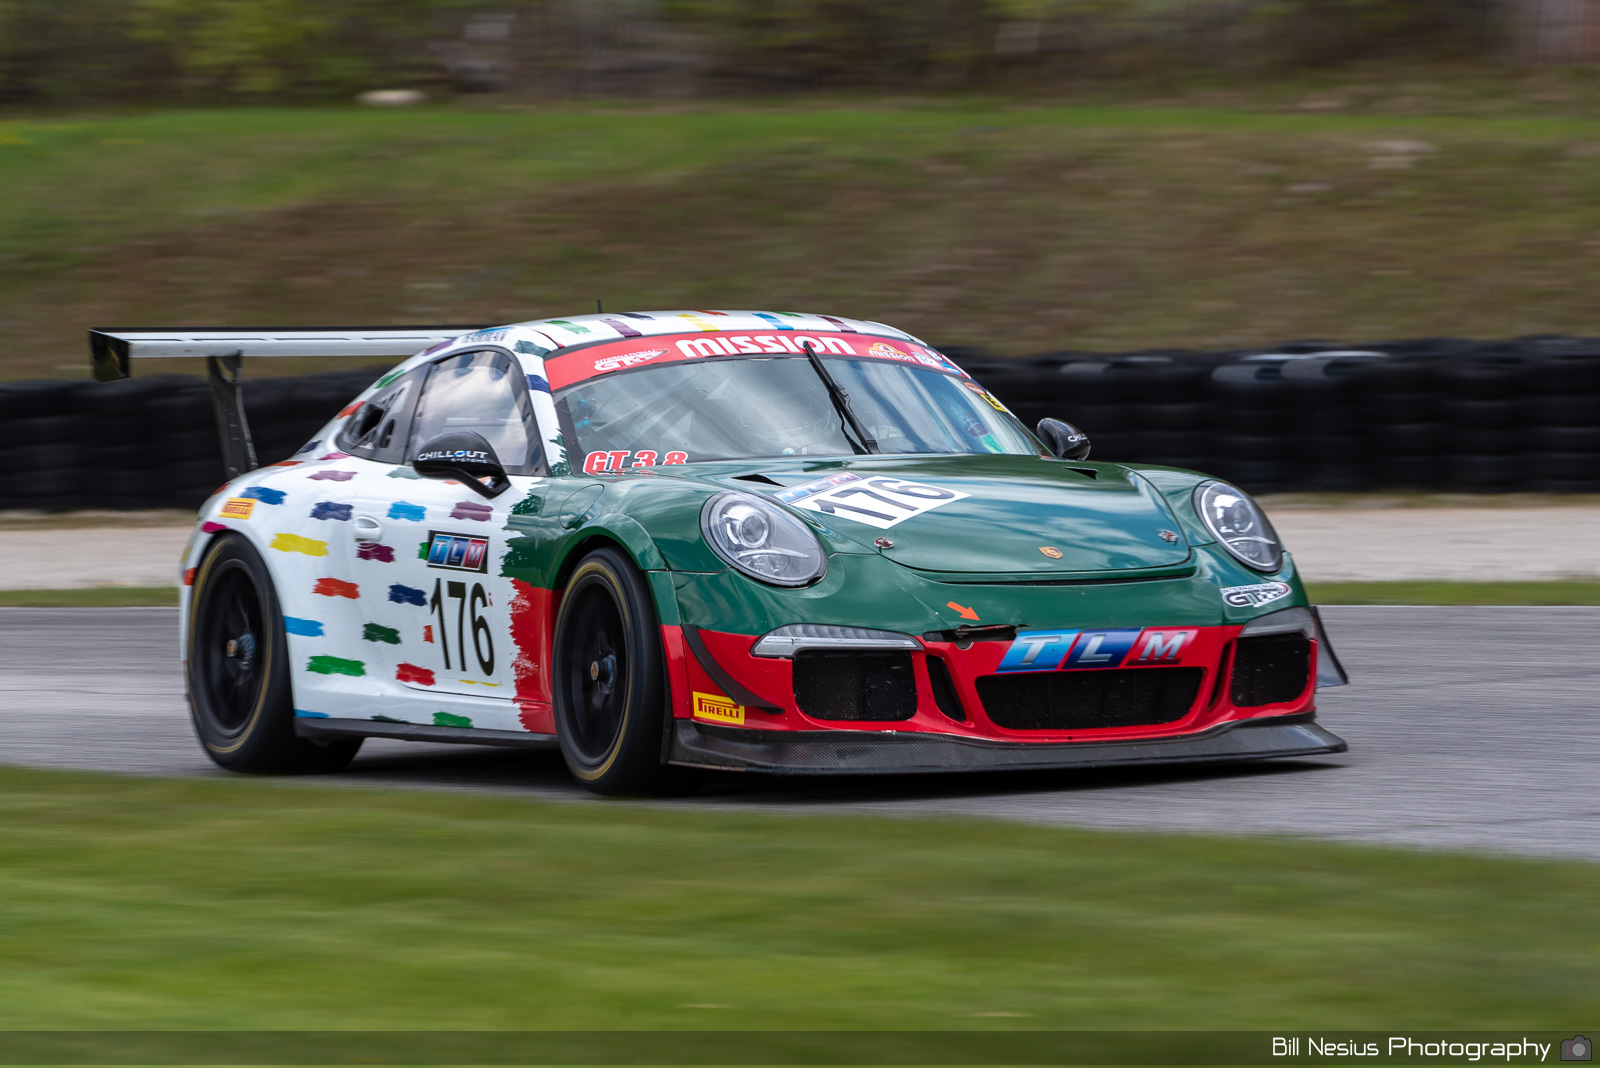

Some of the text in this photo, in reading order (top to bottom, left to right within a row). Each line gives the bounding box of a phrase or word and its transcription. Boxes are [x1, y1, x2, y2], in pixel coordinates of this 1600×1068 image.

[417, 450, 488, 462] CHILLOUT
[583, 450, 631, 475] GT
[813, 479, 956, 522] 176
[430, 577, 495, 677] 176
[697, 697, 740, 718] PIRELLI
